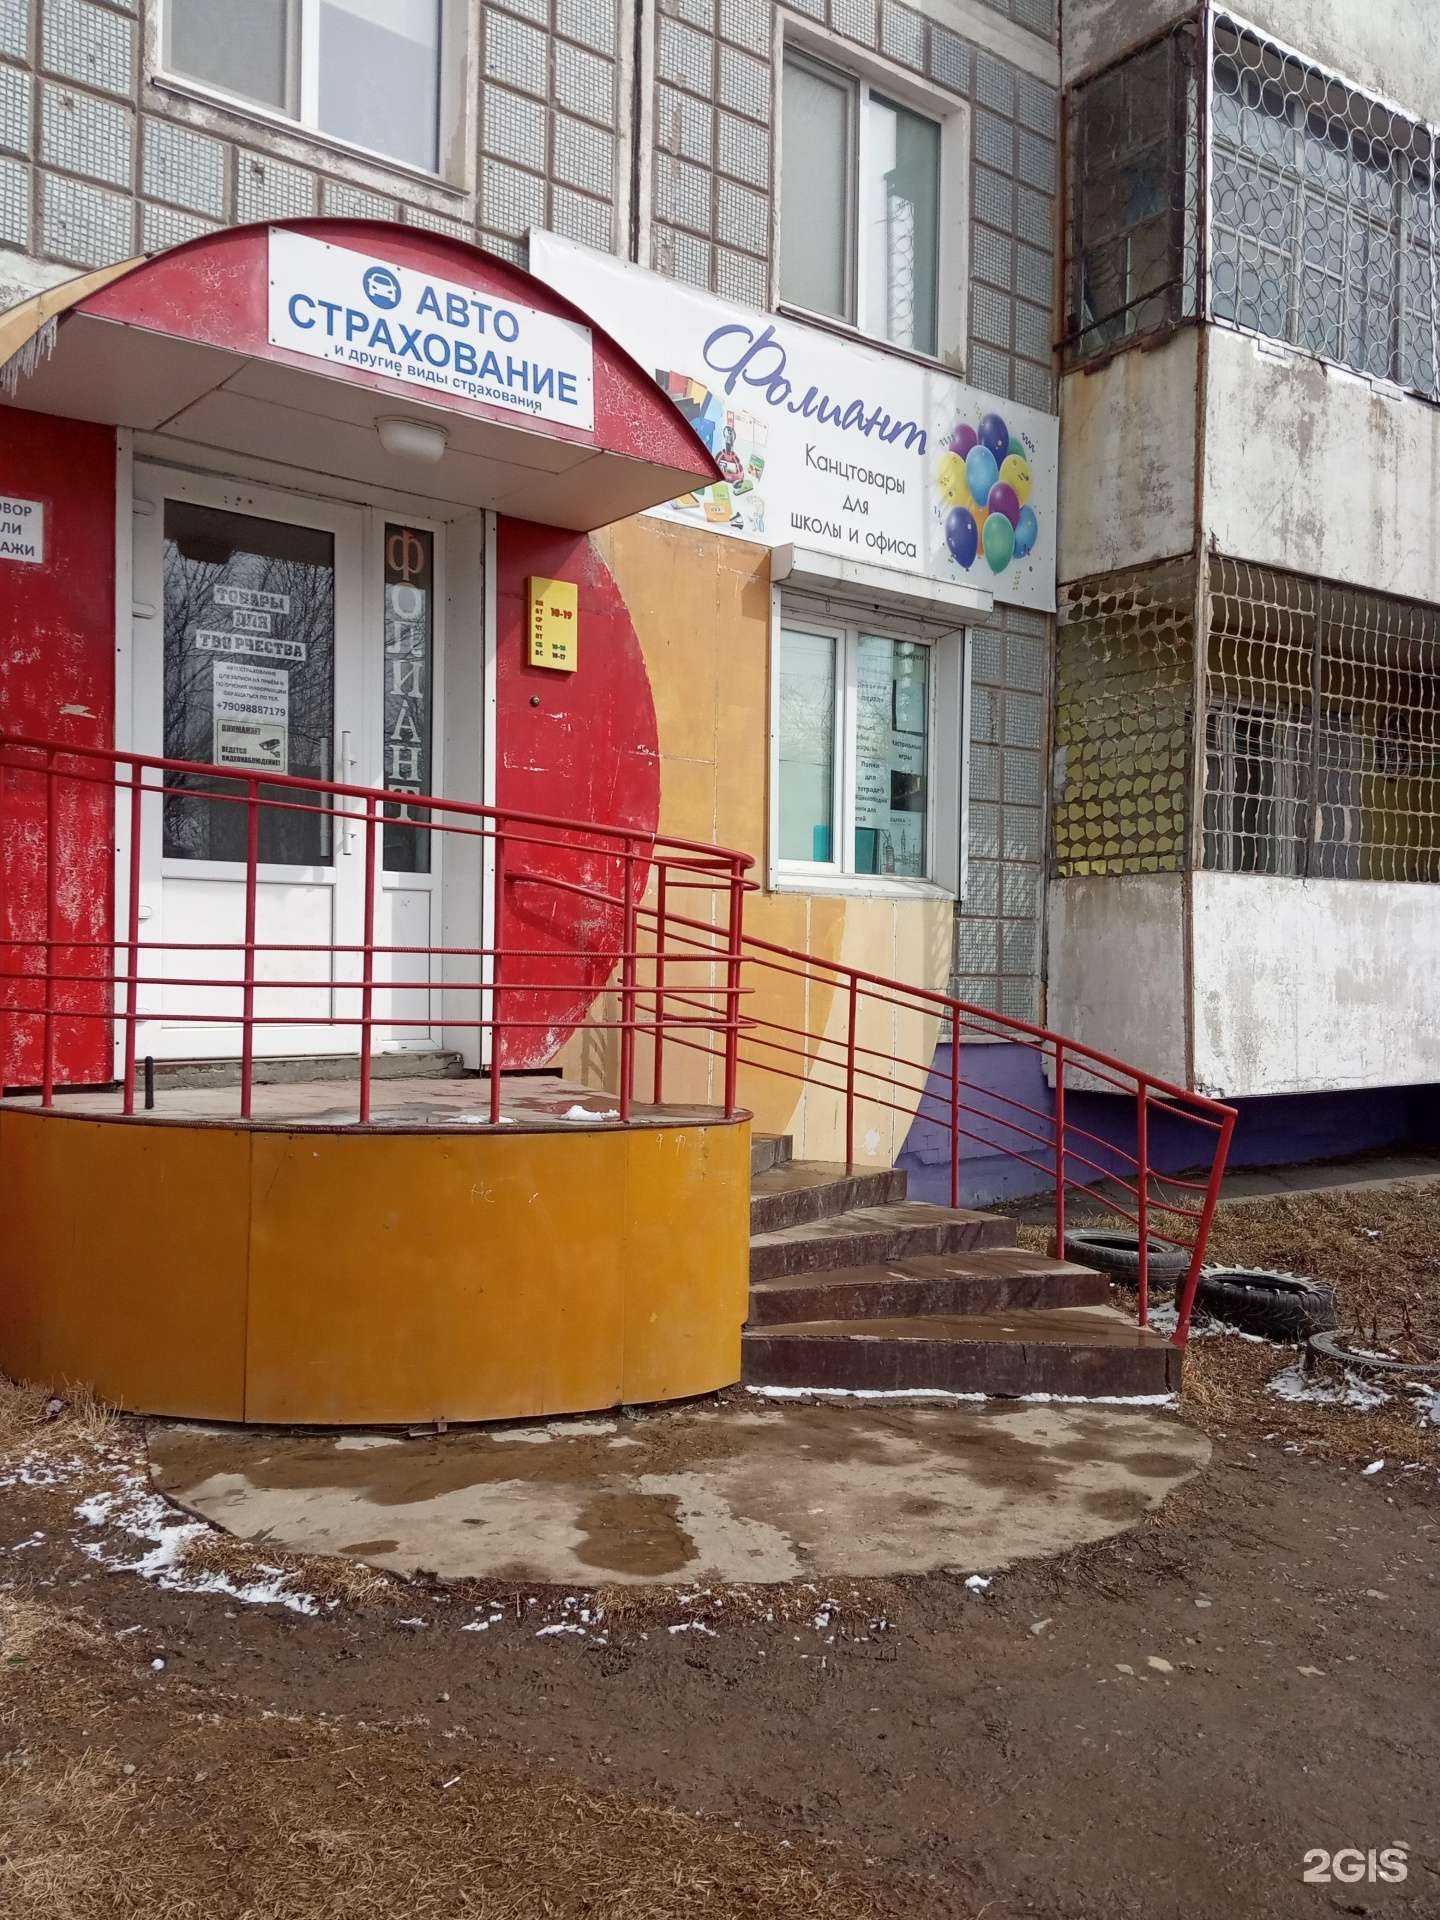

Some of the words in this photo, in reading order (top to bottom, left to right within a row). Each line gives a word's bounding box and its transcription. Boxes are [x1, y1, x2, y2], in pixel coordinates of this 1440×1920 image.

[416, 286, 519, 343] АВТО
[288, 293, 578, 405] СТРАХОВАНИЕ
[334, 344, 344, 356] и
[348, 349, 402, 373] другие
[407, 365, 448, 387] виды
[452, 377, 542, 411] страхования
[703, 324, 928, 456] Фолиант
[805, 443, 906, 495] Канцтовары
[0, 502, 32, 517] ВОР
[843, 496, 869, 517] для
[791, 511, 841, 540] школы
[849, 530, 859, 545] и
[866, 531, 917, 559] офиса
[216, 701, 286, 716] +79098887179
